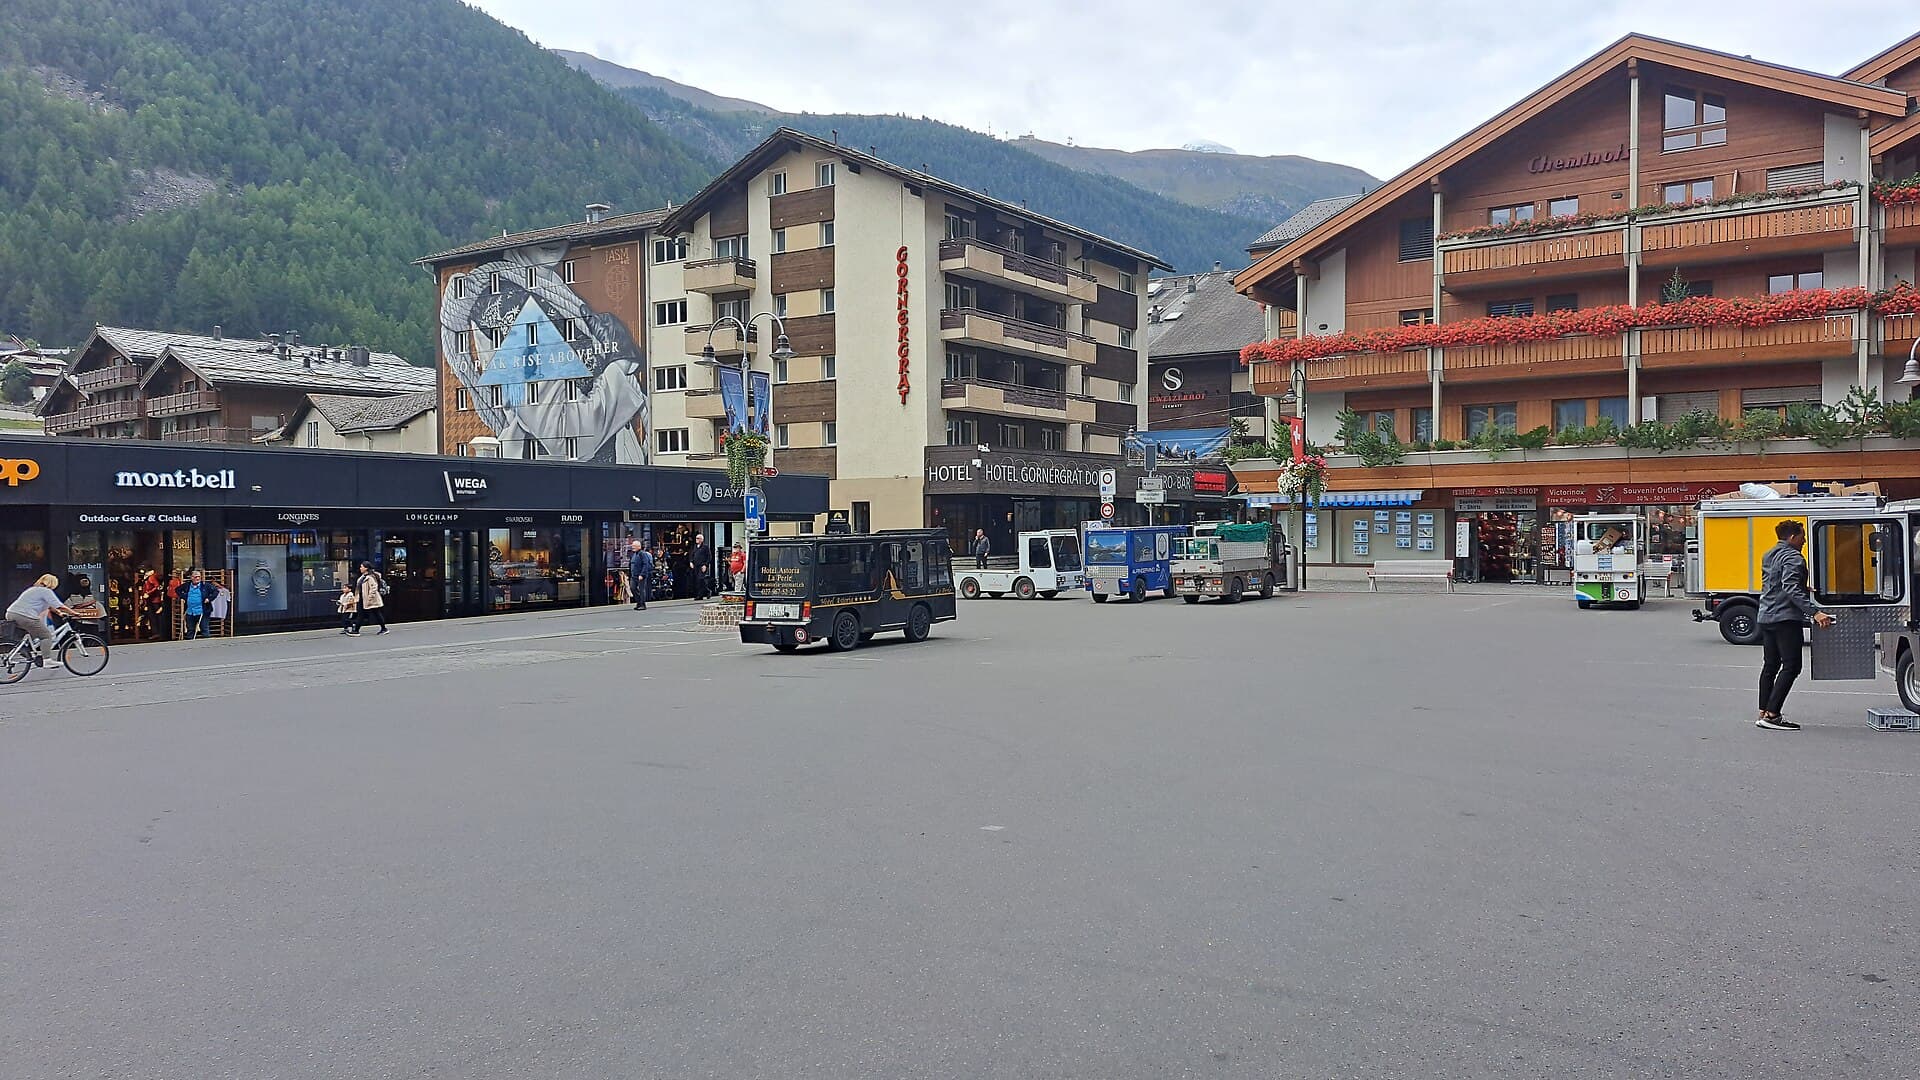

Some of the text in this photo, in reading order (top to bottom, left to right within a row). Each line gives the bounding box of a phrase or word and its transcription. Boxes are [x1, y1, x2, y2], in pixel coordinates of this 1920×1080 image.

[897, 246, 910, 405] GORNERGRAT
[513, 353, 543, 368] RISE
[549, 348, 592, 366] ABOVE
[594, 342, 619, 355] HER
[929, 465, 973, 481] HOTEL
[986, 464, 1098, 485] HOTEL GORNERGRAT DO
[454, 478, 487, 489] WEGA
[715, 488, 746, 502] BAYA
[1549, 488, 1584, 496] Victorinox
[1623, 486, 1679, 495] Souvenir Outlet
[1559, 496, 1586, 504] Engraving
[749, 498, 755, 514] P
[79, 514, 198, 524] Outdoor Gear & Clothing
[278, 513, 320, 521] LONGINES
[406, 514, 459, 522] LONGCHAMP
